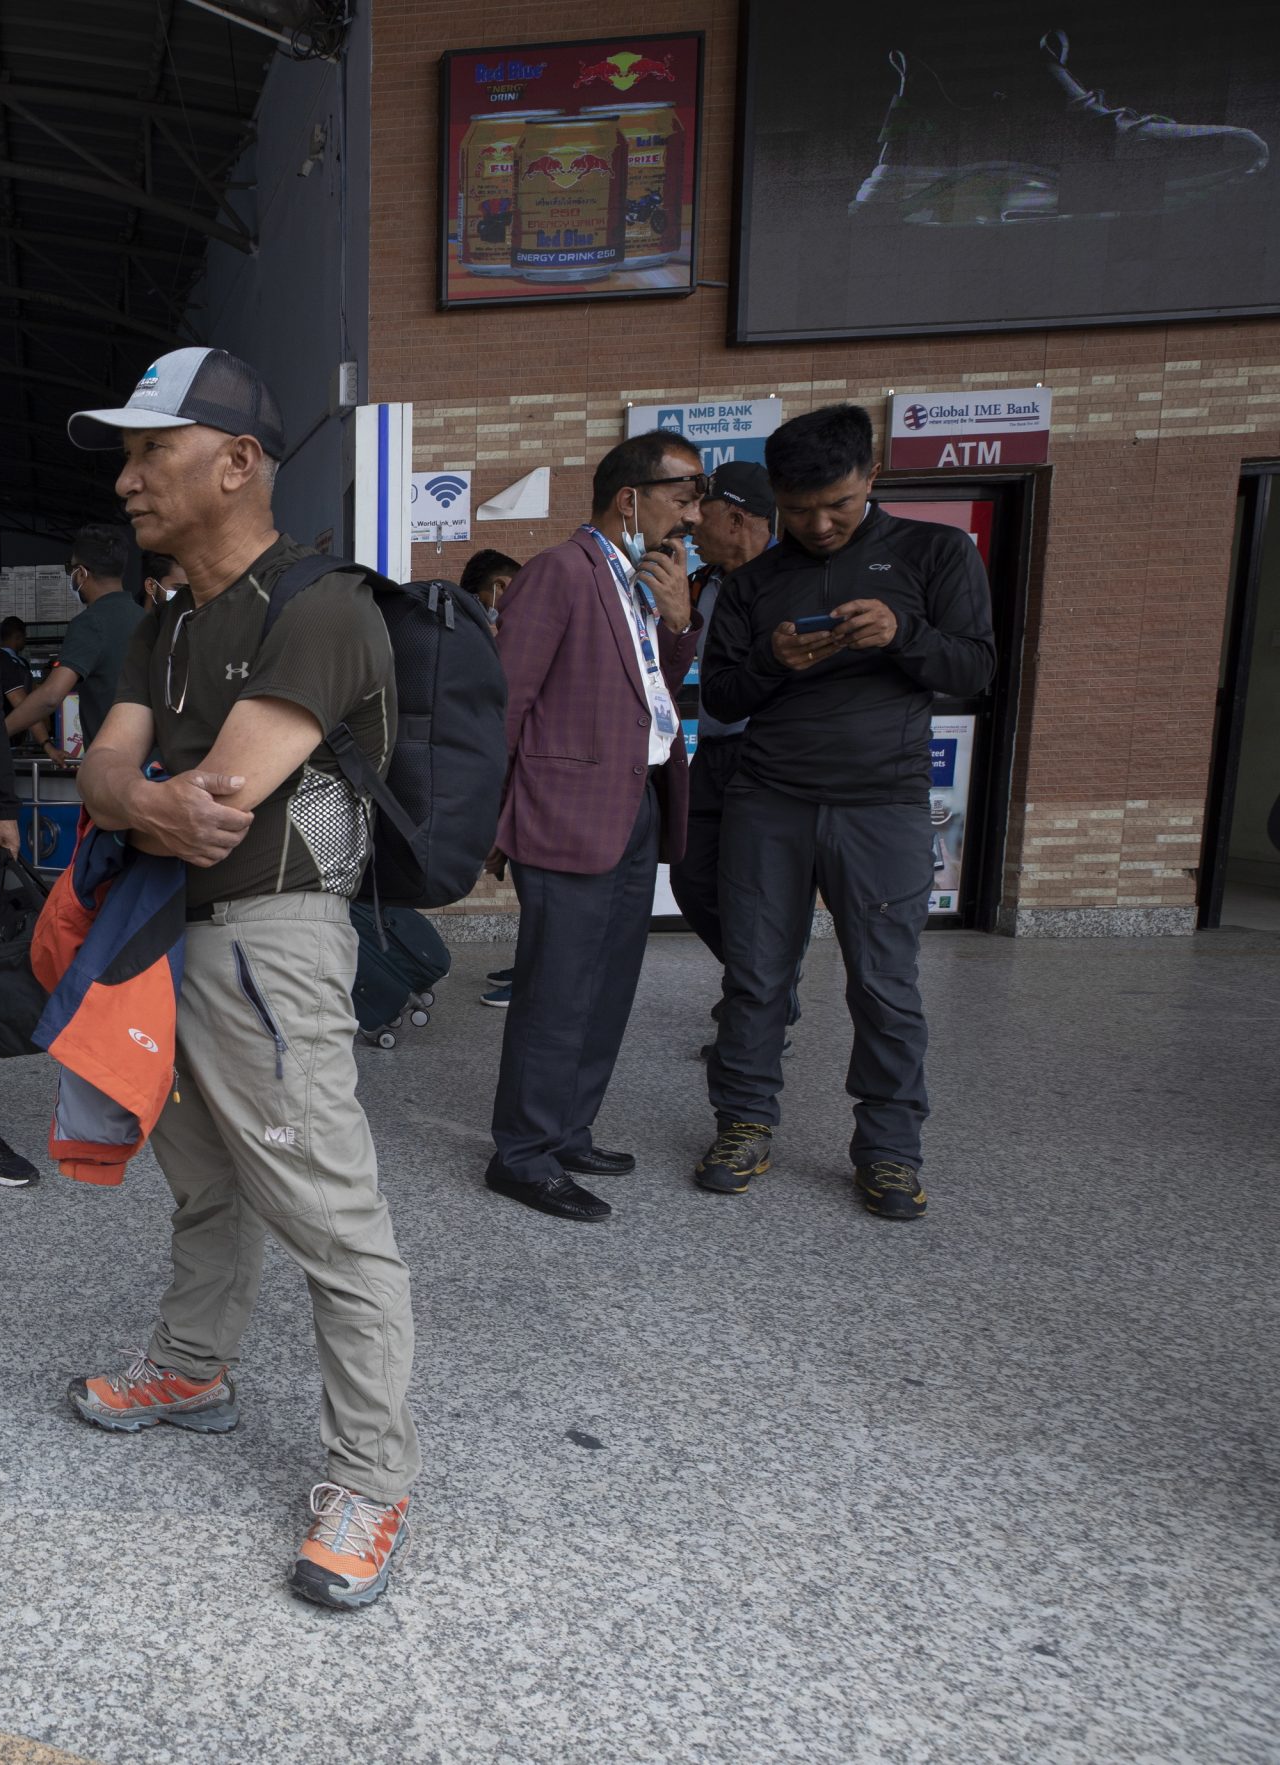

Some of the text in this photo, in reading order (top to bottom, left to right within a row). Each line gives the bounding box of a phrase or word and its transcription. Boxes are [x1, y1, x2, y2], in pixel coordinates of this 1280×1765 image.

[475, 60, 543, 83] Red Blue
[550, 207, 580, 218] 250
[536, 228, 594, 248] Red Blue
[517, 252, 556, 262] ENERGY
[558, 250, 595, 262] DRINK
[596, 248, 616, 259] 250
[688, 405, 752, 419] NMB BANK
[928, 402, 1040, 418] Global IME Bank
[937, 440, 1002, 468] ATM
